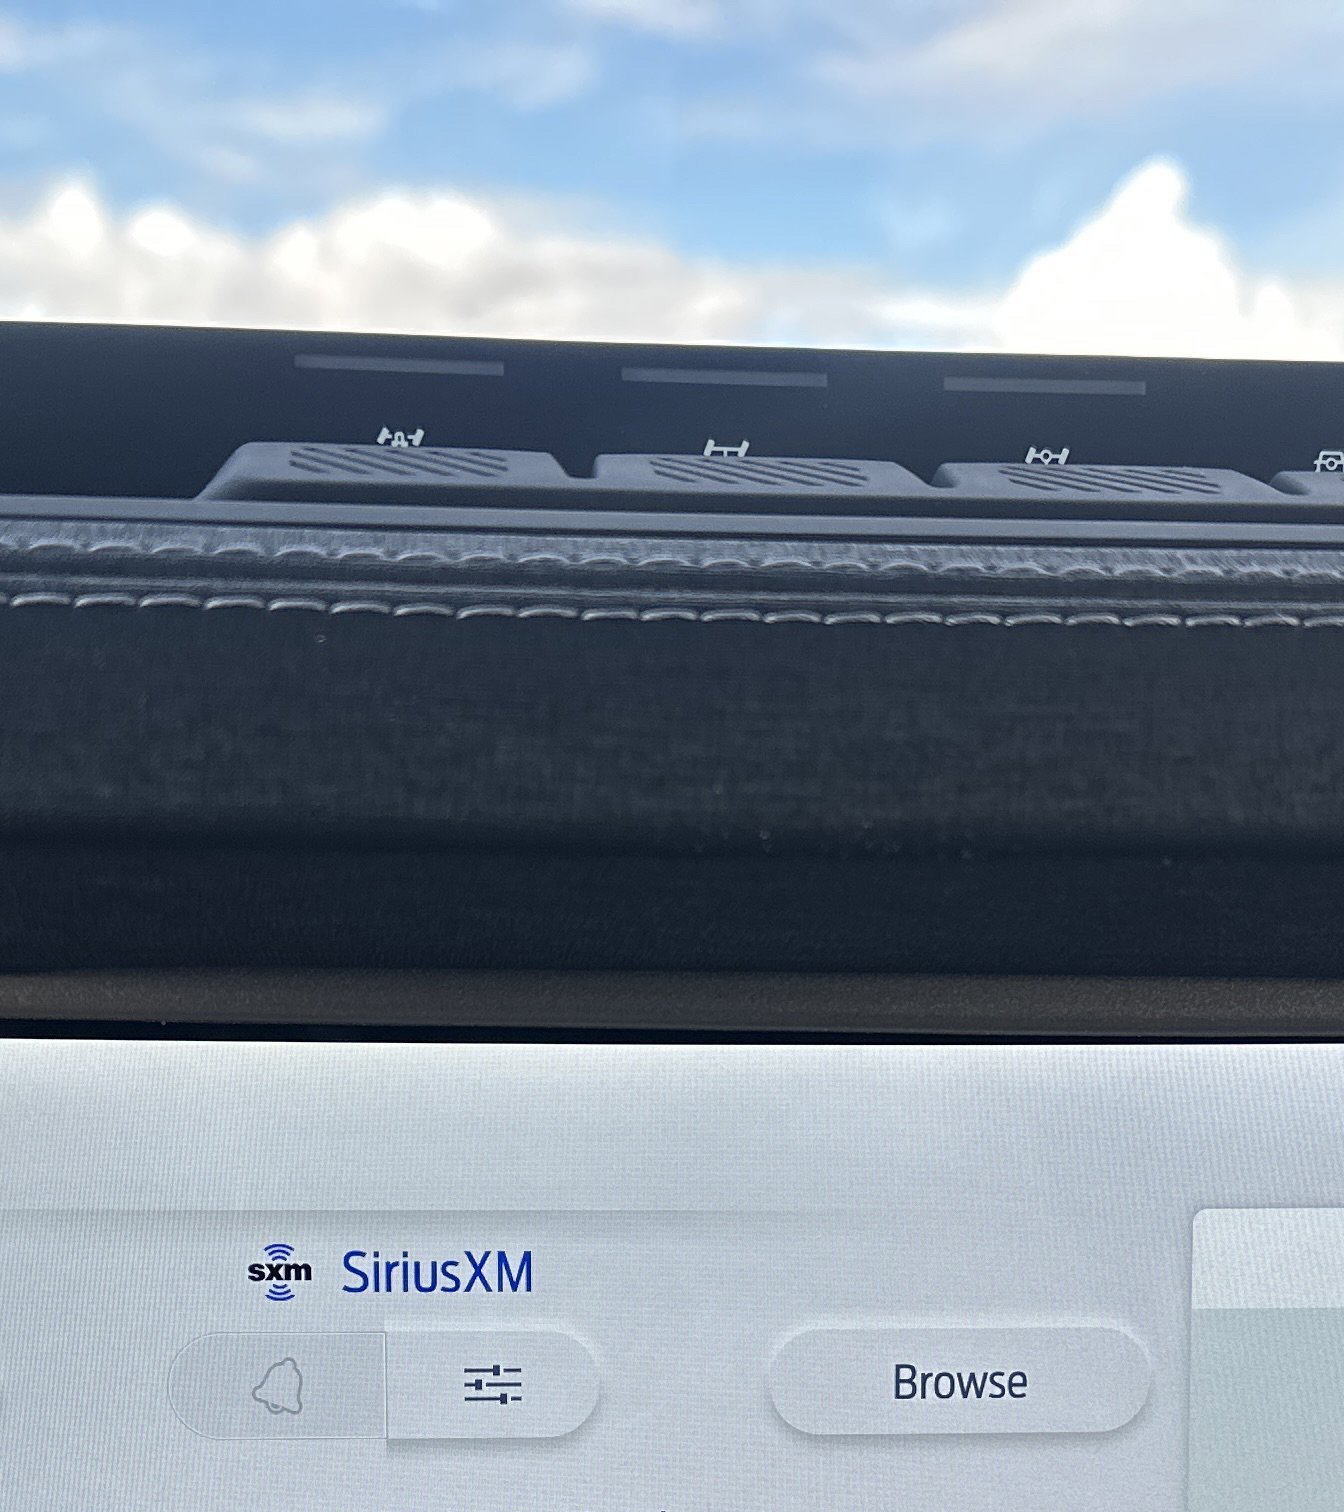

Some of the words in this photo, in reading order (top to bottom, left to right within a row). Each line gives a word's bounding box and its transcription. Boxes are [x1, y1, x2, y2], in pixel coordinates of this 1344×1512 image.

[247, 1259, 312, 1283] sxm
[341, 1250, 532, 1293] SiriusXM
[894, 1363, 1028, 1400] Browse
